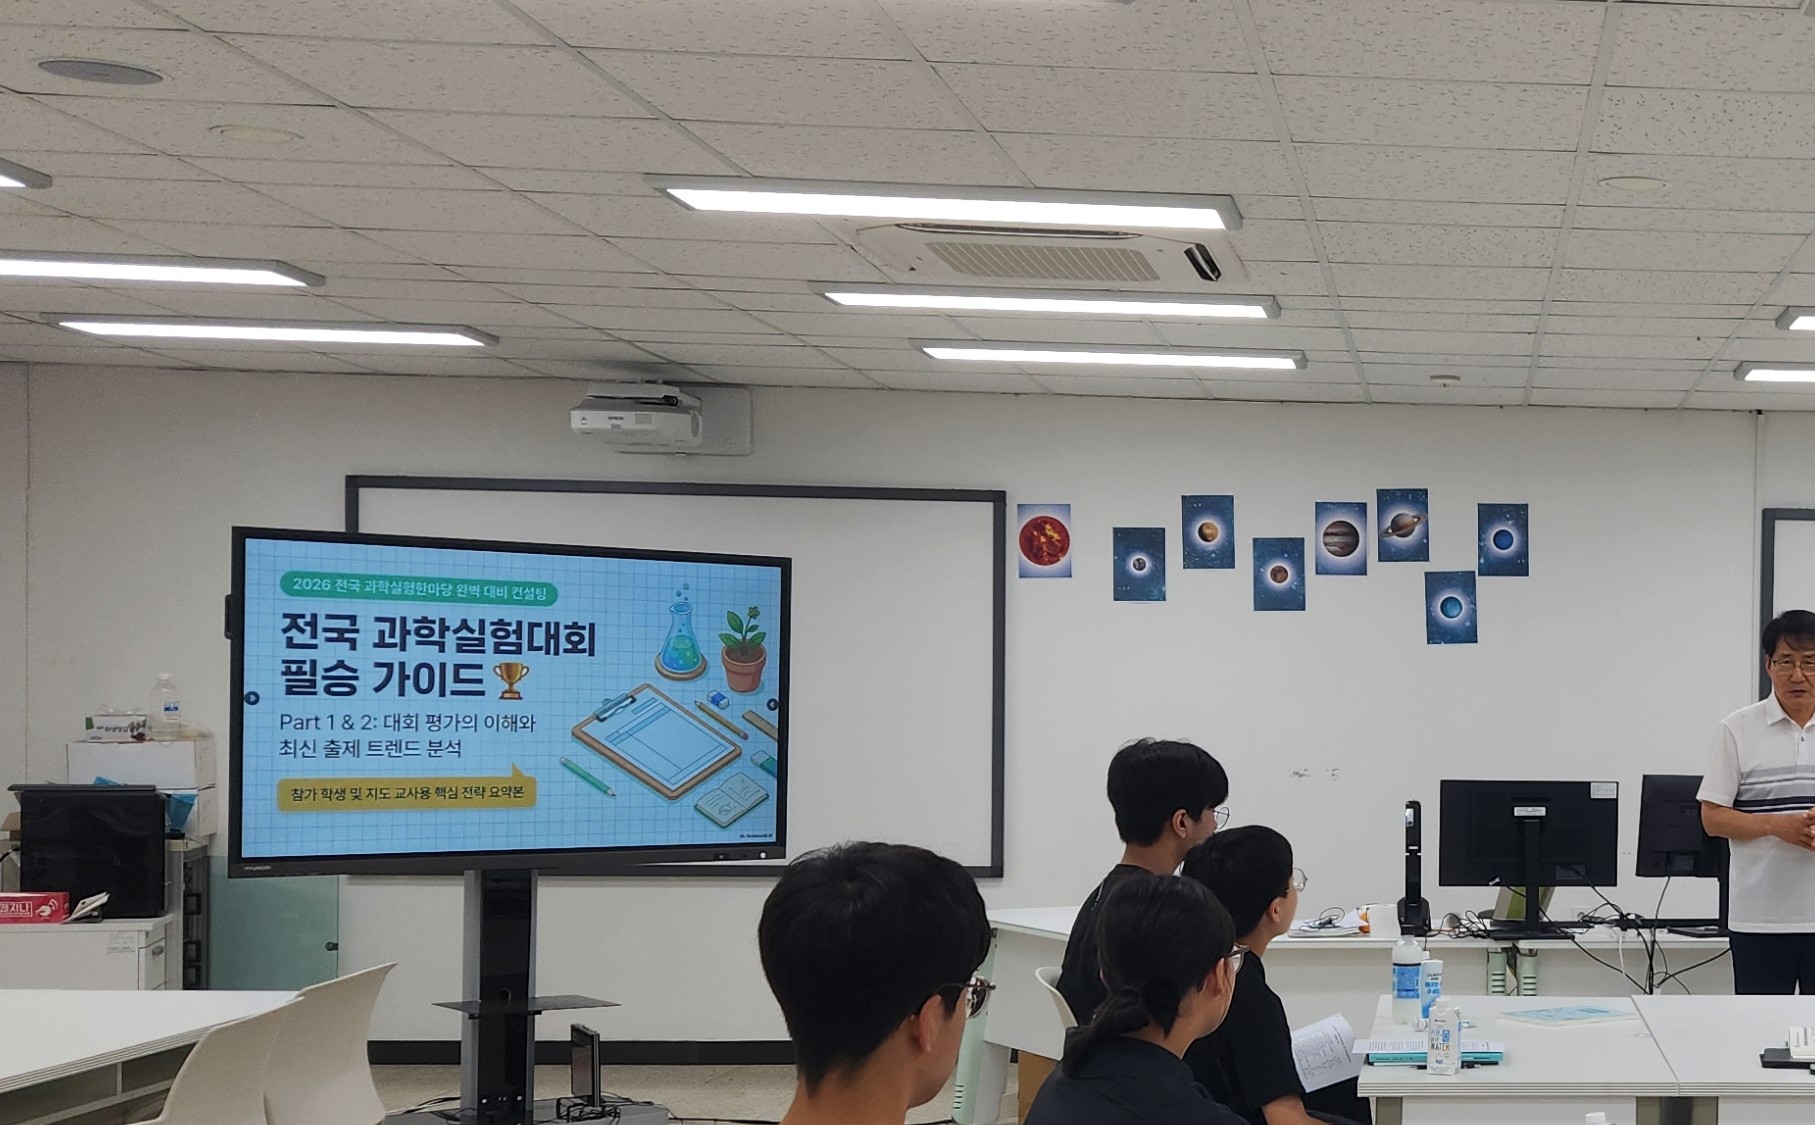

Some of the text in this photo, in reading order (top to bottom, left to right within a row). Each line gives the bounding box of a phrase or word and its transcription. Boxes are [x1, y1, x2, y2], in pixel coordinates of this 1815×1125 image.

[293, 577, 547, 601] 2026 전국 과학실험한마당 완벽 대비 컨설팅
[281, 613, 596, 657] 전국 과학실험대회
[281, 659, 486, 698] 필승 가이드
[280, 713, 537, 733] Part 1 & 2: 대회 평가의 이해와
[279, 739, 462, 759] 최신 출제 트렌드 분석
[291, 785, 525, 802] 참가 학생 및 지도 교사용 핵심 전략 요약본
